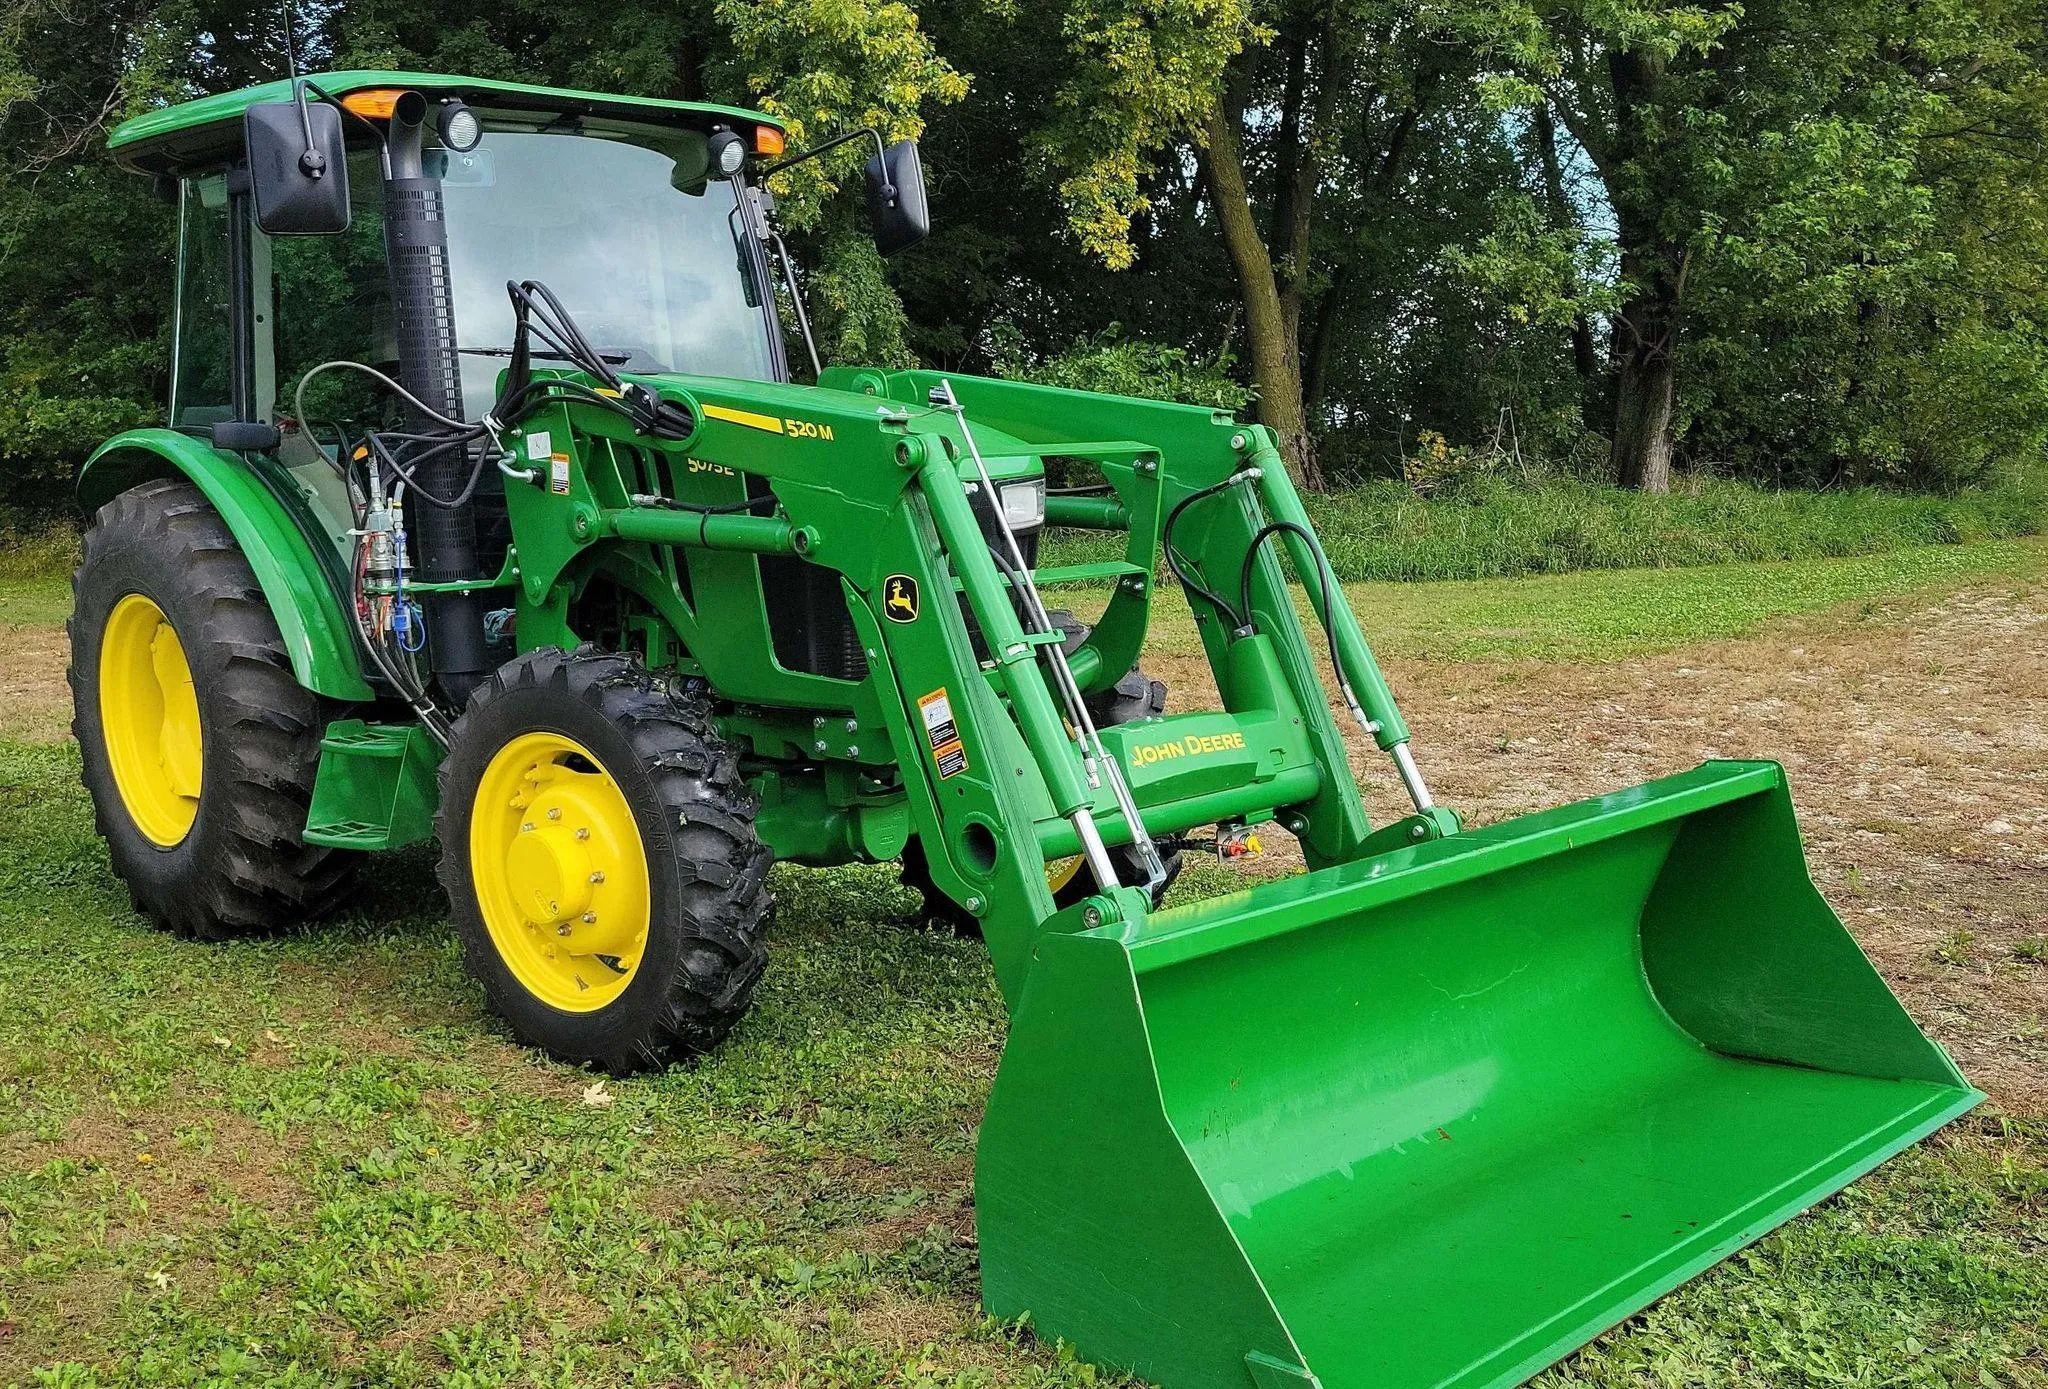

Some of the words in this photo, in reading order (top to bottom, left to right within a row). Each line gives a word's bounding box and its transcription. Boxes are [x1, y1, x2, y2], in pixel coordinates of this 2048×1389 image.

[785, 418, 817, 438] 520
[818, 425, 834, 441] M
[1132, 742, 1185, 766] JOHN
[1184, 733, 1246, 754] DEERE
